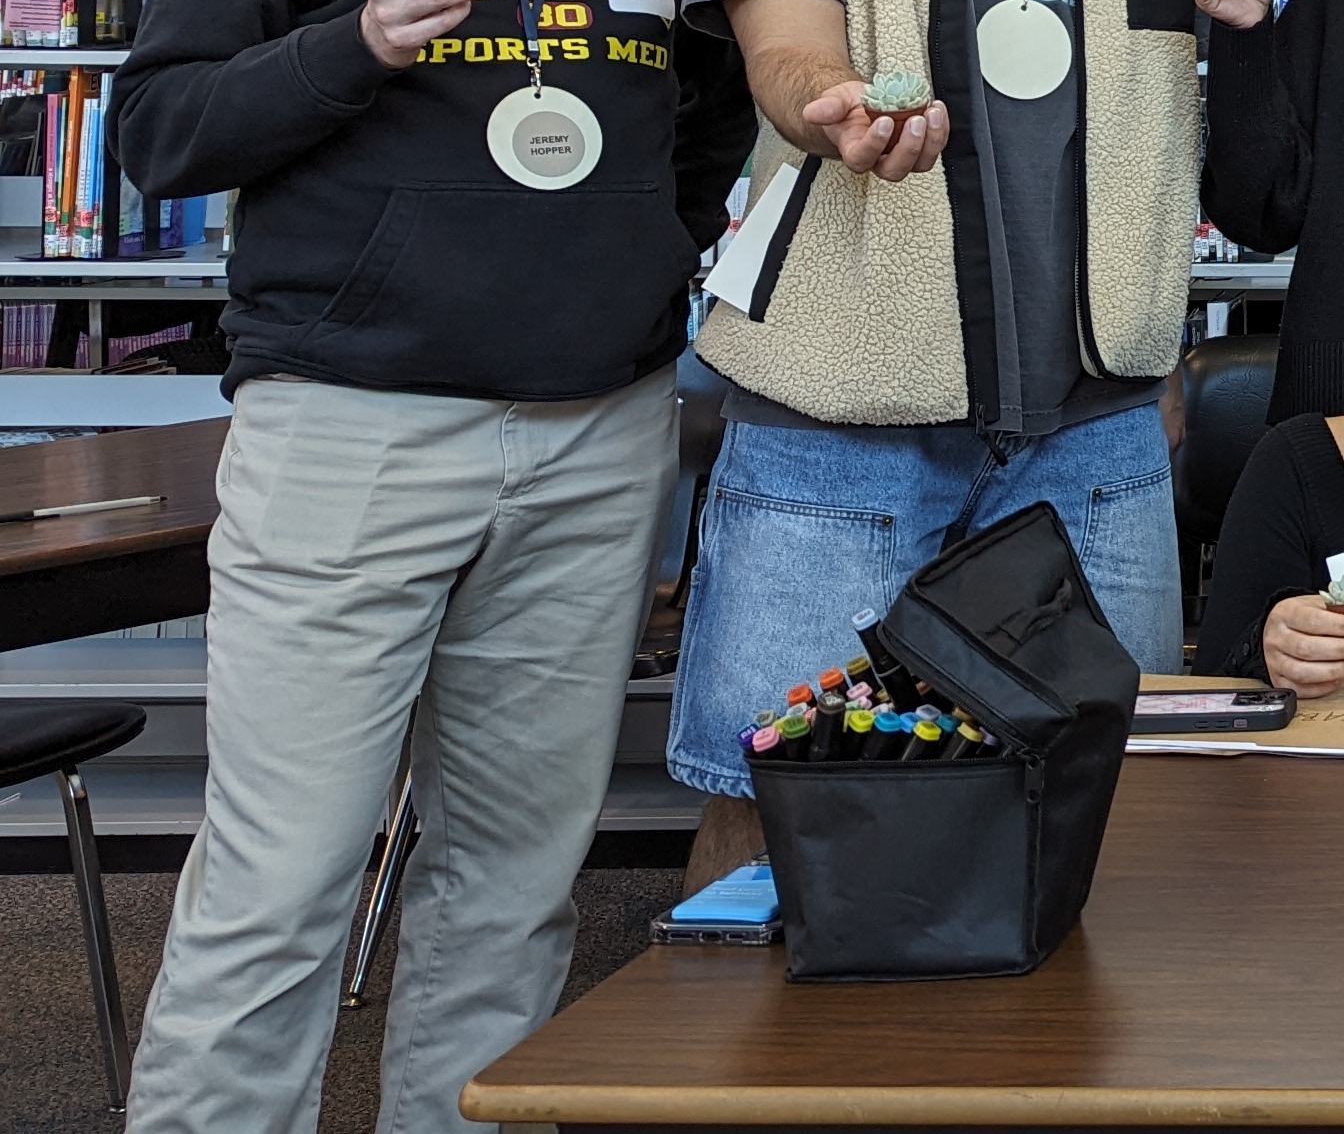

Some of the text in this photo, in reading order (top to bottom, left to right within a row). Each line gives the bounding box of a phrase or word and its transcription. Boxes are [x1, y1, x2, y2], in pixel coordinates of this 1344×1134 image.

[606, 36, 669, 71] MED
[529, 134, 570, 145] JEREMY
[530, 146, 572, 156] HOPPER
